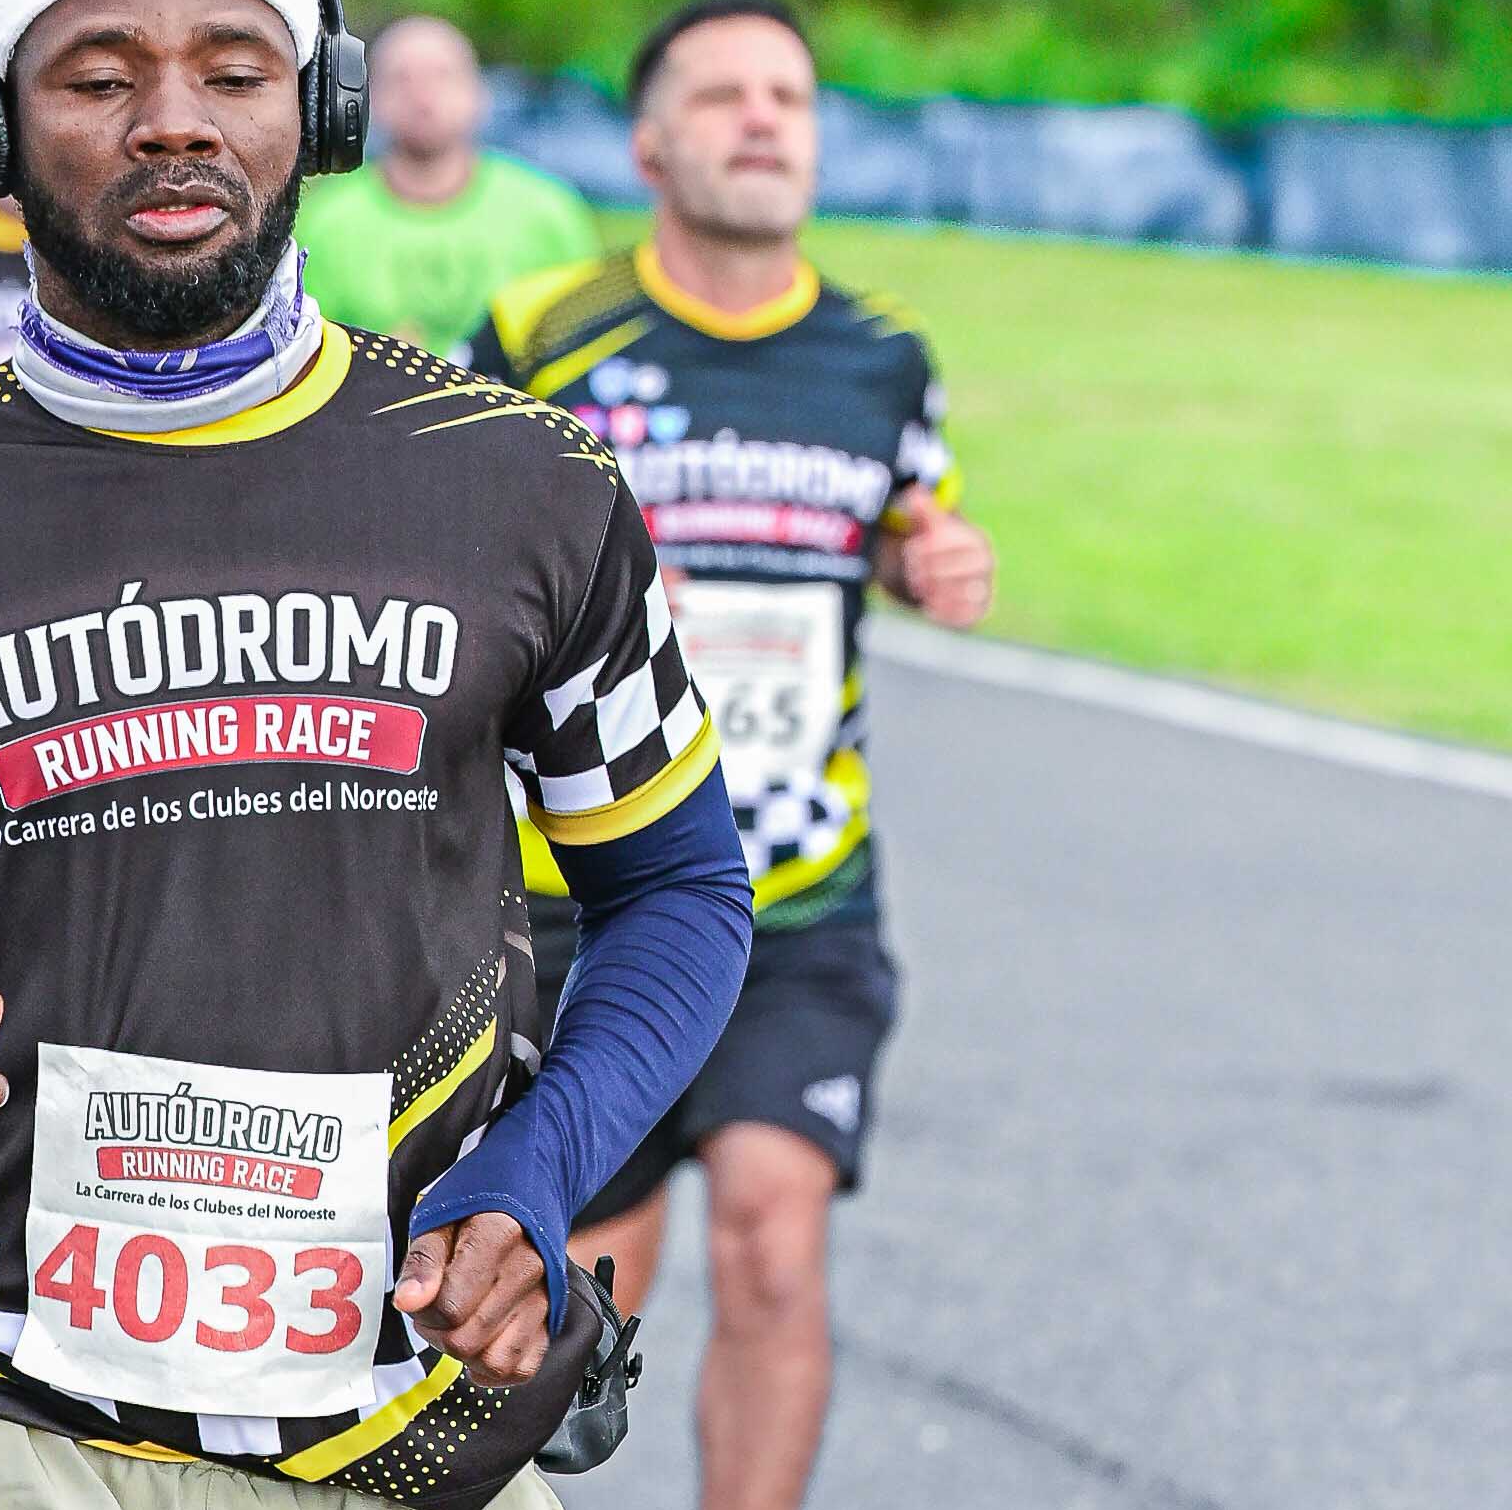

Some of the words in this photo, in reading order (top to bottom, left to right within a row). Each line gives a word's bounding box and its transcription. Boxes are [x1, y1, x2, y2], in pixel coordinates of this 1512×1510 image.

[33, 704, 239, 791] RUNNING
[254, 703, 377, 761] RACE
[3, 811, 96, 846] Carrera
[103, 800, 136, 831] de
[143, 795, 182, 825] los
[189, 786, 282, 820] Clubes
[289, 781, 332, 812] del
[340, 781, 439, 812] Noroeste
[85, 1082, 341, 1163] AUTÓDROMO
[75, 1181, 91, 1197] La
[94, 1184, 144, 1205] Carrera
[148, 1192, 166, 1209] de
[169, 1194, 189, 1211] los
[193, 1198, 243, 1217] Clubes
[247, 1202, 270, 1218] del
[274, 1203, 337, 1220] Noroeste
[121, 1151, 225, 1182] RUNNING
[232, 1160, 297, 1194] RACE
[34, 1224, 363, 1355] 4033
